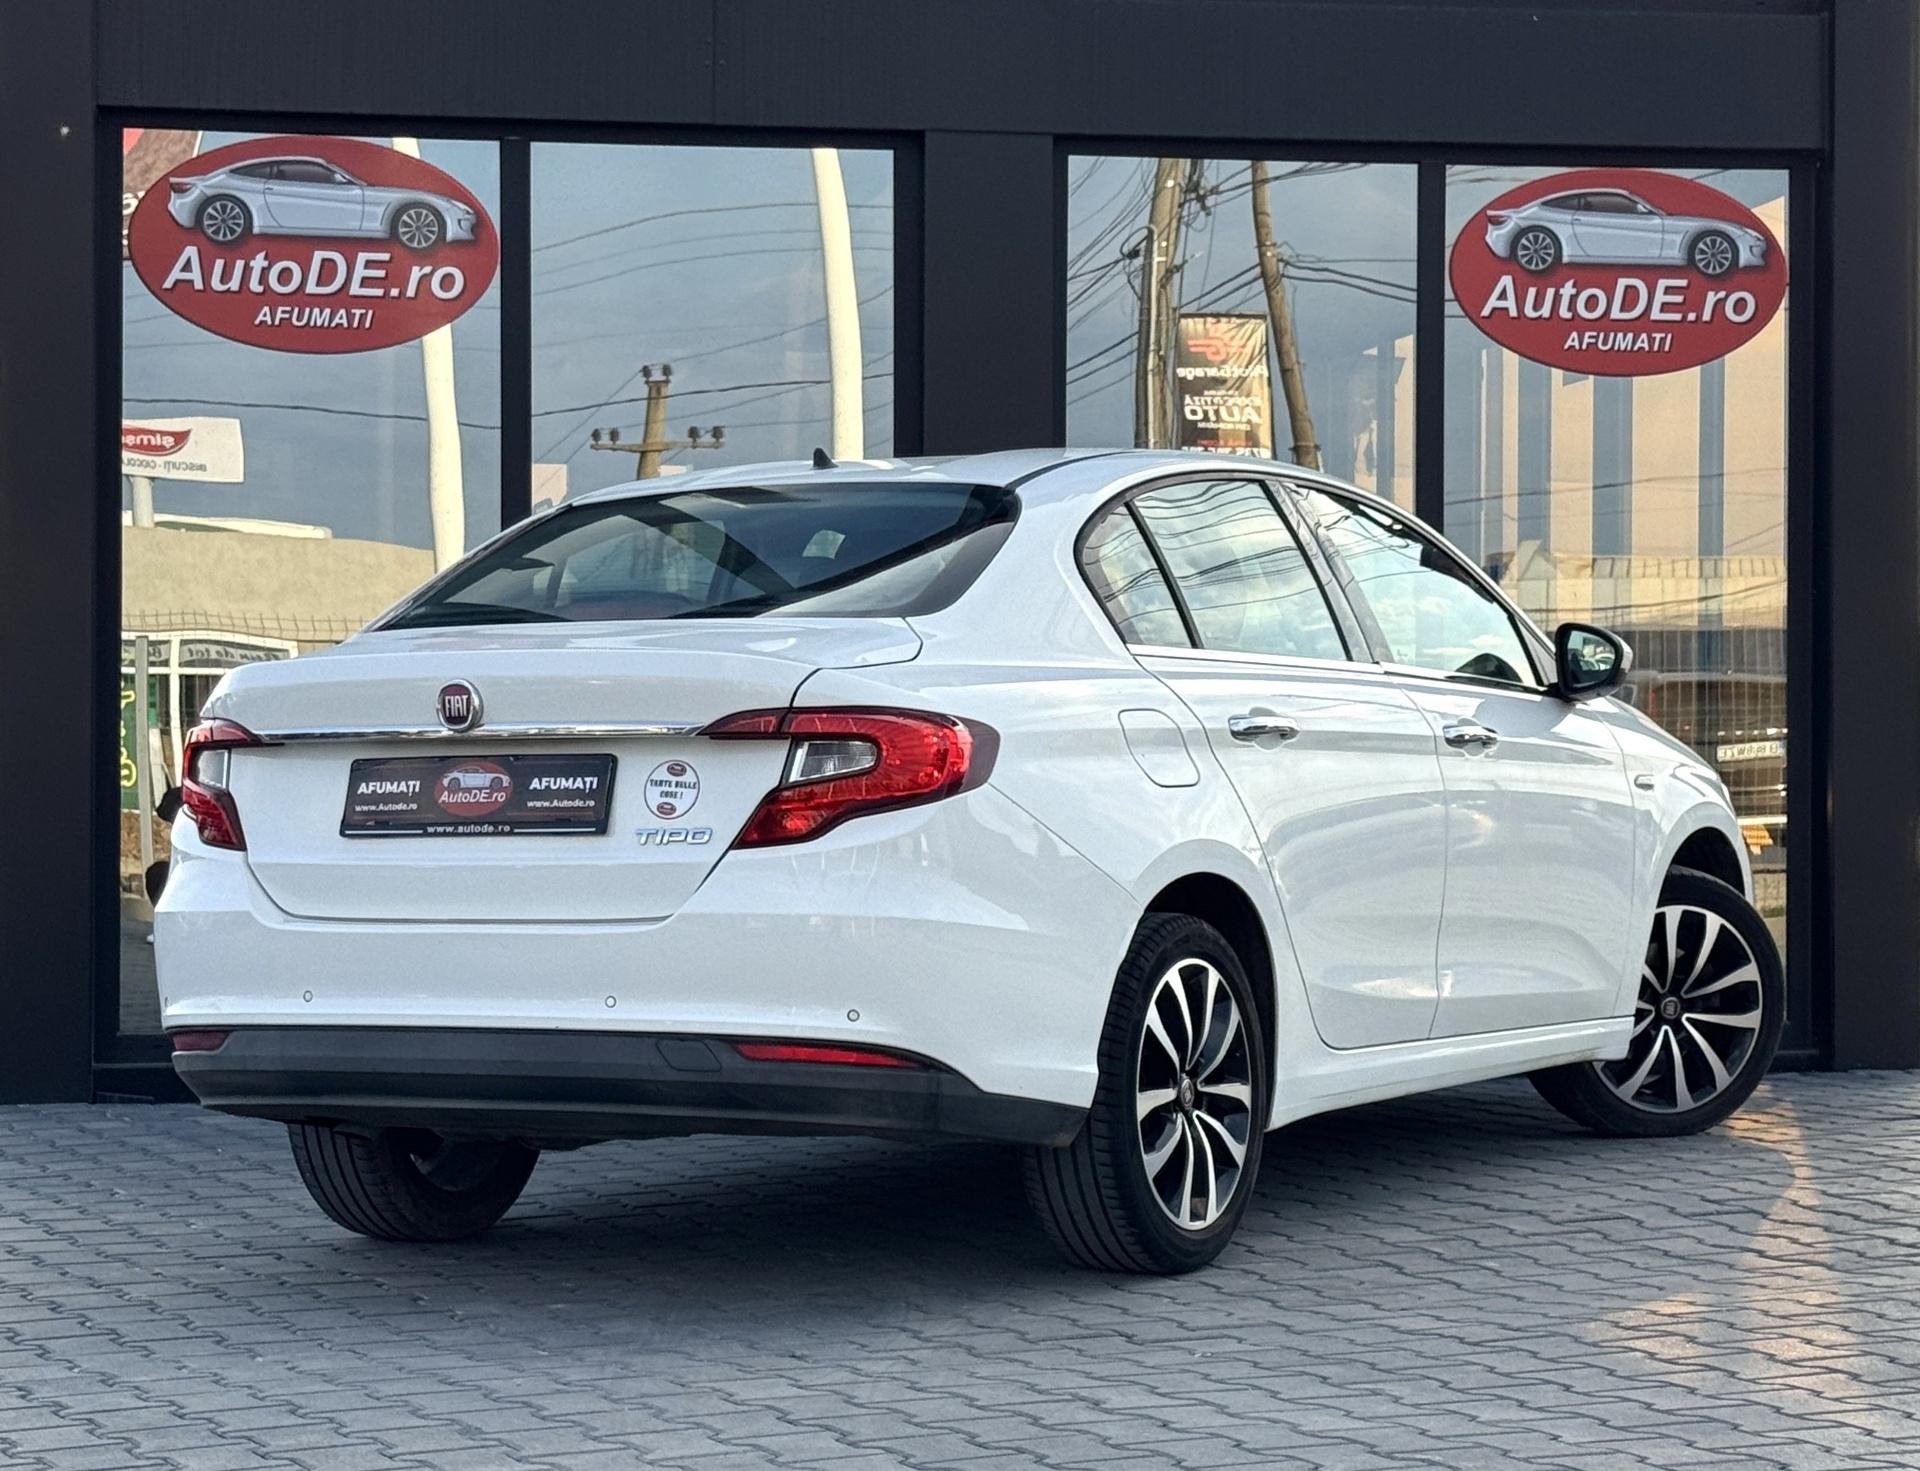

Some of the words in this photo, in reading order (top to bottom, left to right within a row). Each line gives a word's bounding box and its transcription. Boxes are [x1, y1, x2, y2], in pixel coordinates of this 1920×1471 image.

[162, 245, 466, 300] AutoDE.ro
[1480, 274, 1757, 324] AutoDE.ro
[254, 306, 375, 330] AFUMATI
[1563, 331, 1673, 352] AFUMATI
[444, 694, 469, 718] FIAT
[438, 789, 507, 804] AutoDE.ro
[426, 823, 512, 834] www.autode.ro
[635, 827, 714, 846] TIPO
